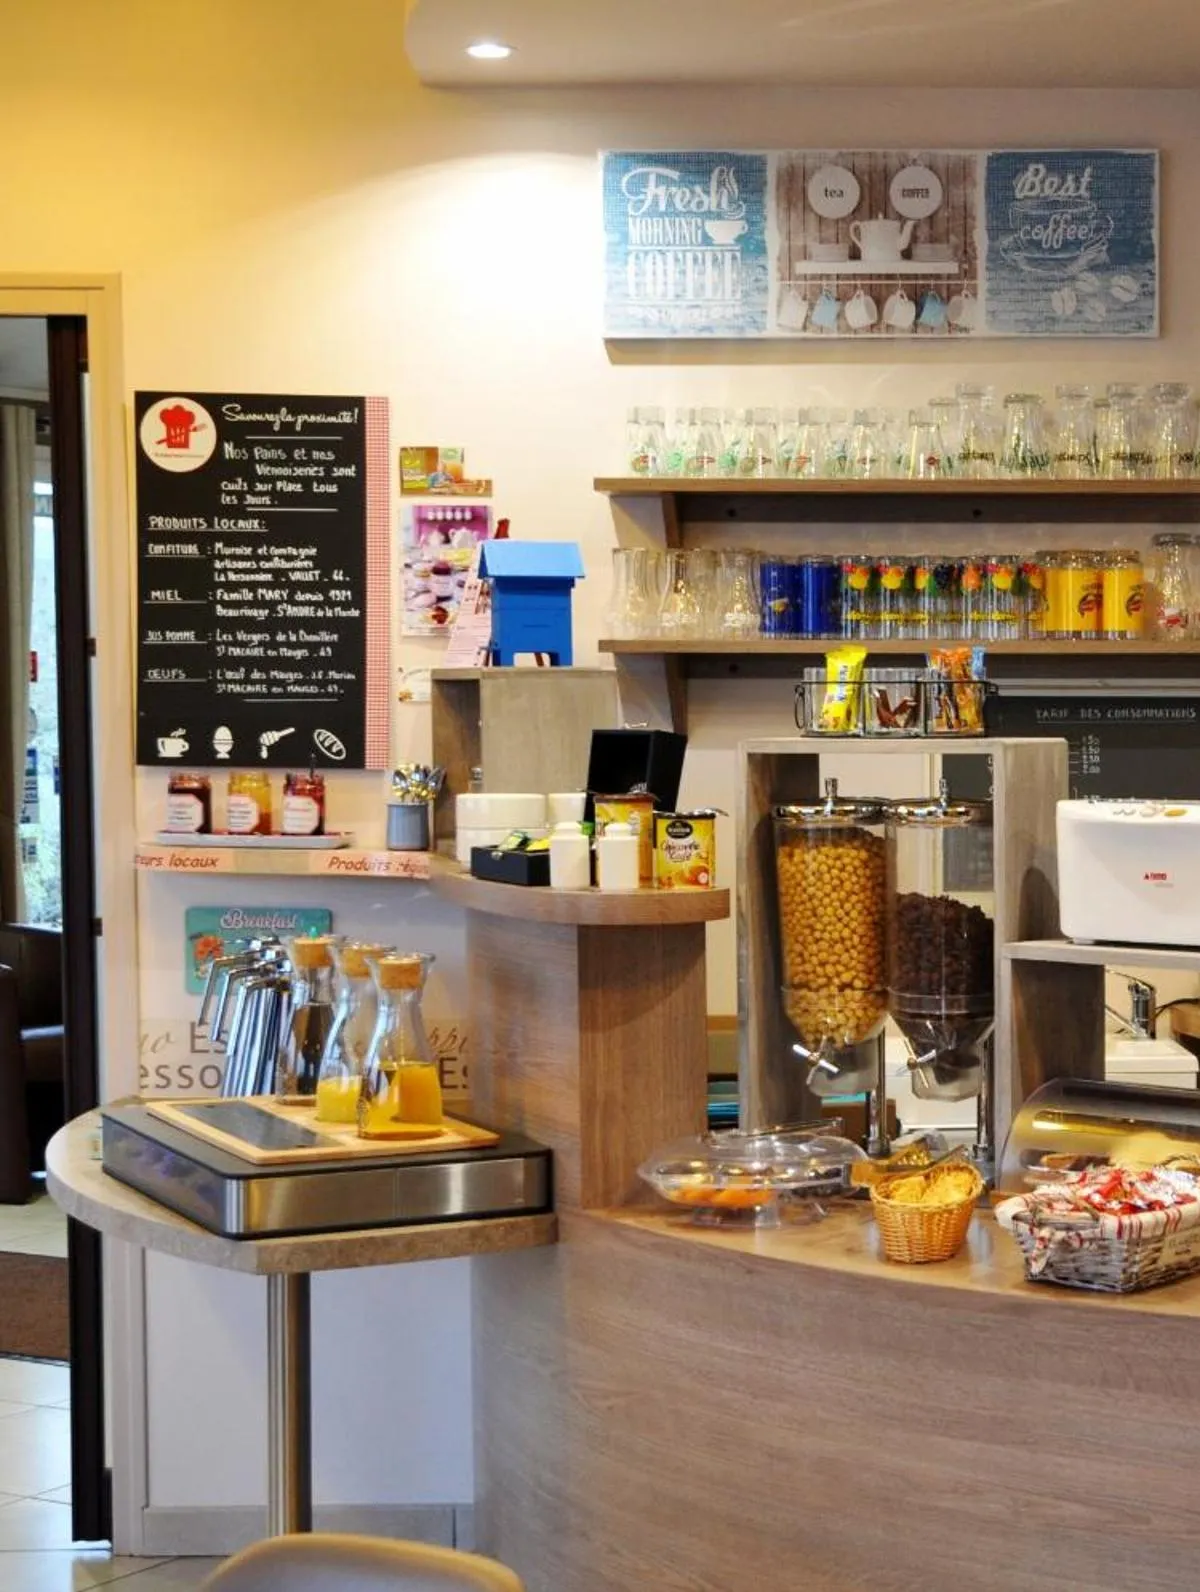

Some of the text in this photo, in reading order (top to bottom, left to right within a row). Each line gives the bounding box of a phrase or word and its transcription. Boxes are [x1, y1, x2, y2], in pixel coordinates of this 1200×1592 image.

[1015, 163, 1093, 199] Best
[622, 166, 729, 216] Fresh
[824, 187, 844, 199] tea
[629, 217, 703, 245] MORNING
[1020, 212, 1089, 248] coffee
[628, 251, 741, 299] COFFEE
[223, 441, 248, 460] Nos
[294, 447, 307, 460] et
[312, 450, 335, 460] nos
[332, 464, 356, 477] sont
[254, 482, 272, 491] sur
[313, 481, 338, 492] tous
[221, 494, 238, 504] les
[149, 516, 207, 529] PRODUITS
[152, 591, 182, 600] MIEL
[258, 588, 289, 600] MARY
[251, 669, 266, 680] des
[169, 852, 220, 868] locaux
[328, 856, 392, 872] Produits
[220, 908, 297, 932] Breakfast
